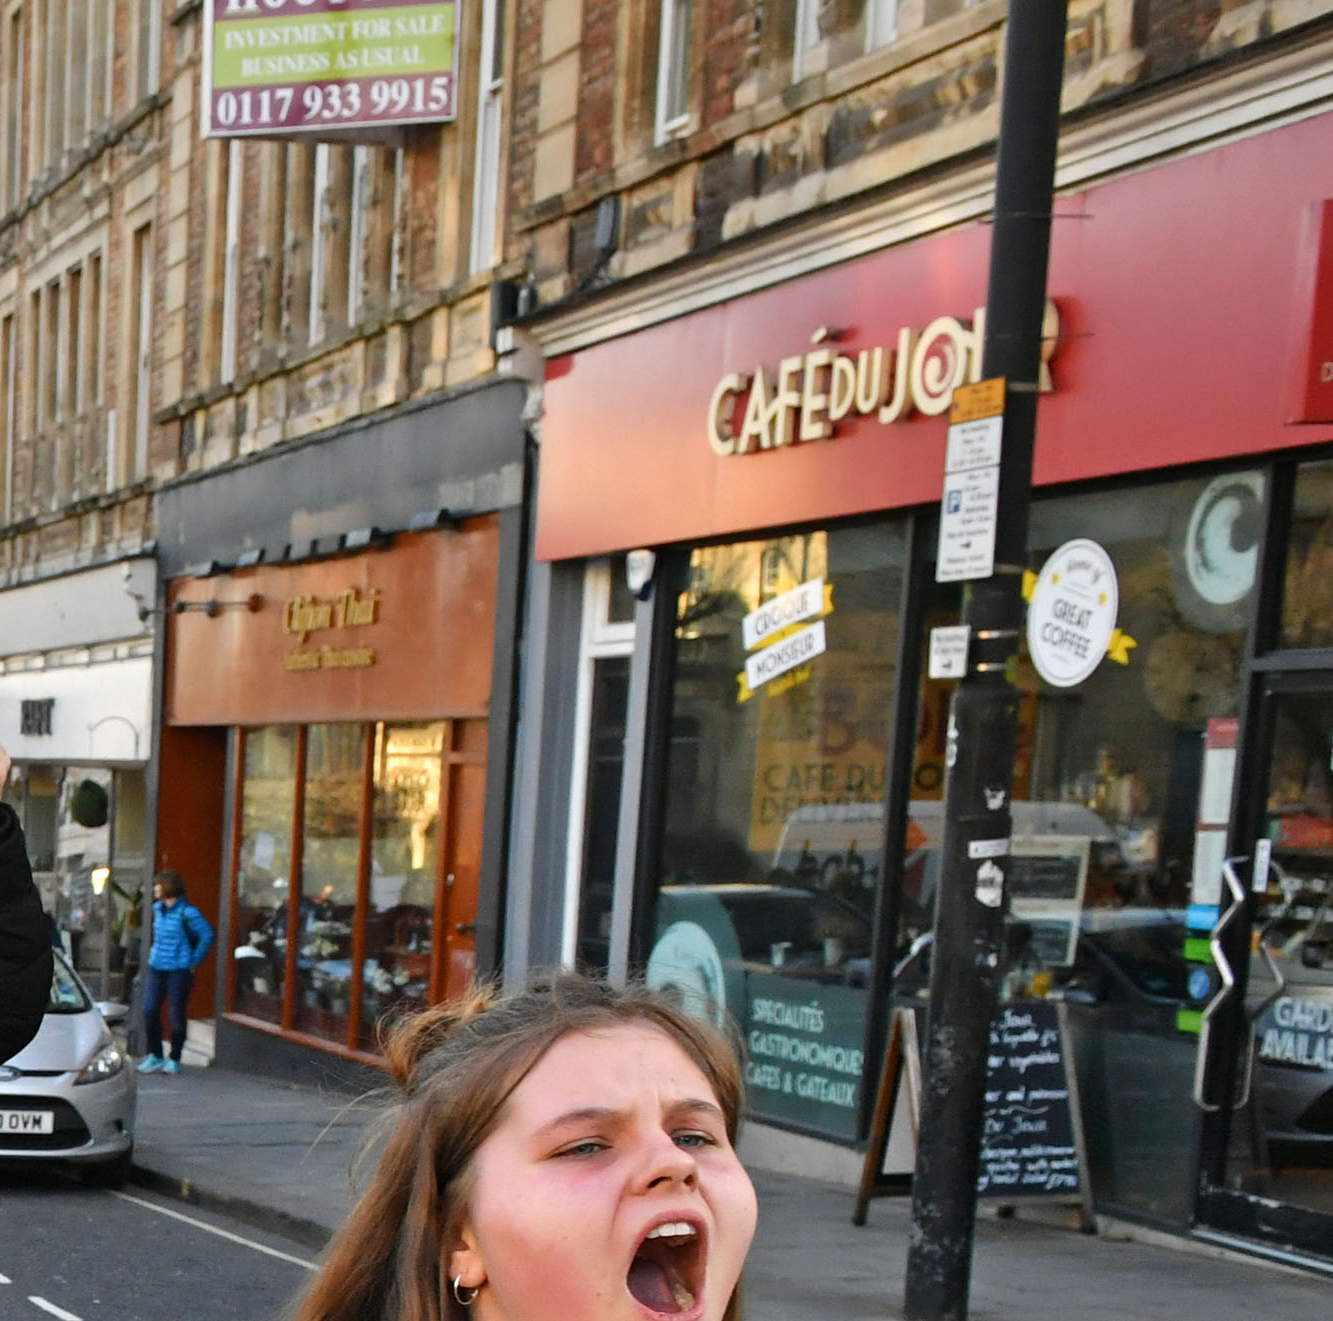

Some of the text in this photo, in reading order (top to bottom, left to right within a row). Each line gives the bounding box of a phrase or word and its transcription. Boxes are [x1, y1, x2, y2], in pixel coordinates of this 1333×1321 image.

[225, 14, 445, 50] INVESTMENT FOR SALE
[241, 45, 425, 77] BUSINESS AS USUAL
[216, 76, 450, 126] 0117 933 9915
[708, 325, 833, 456] CAFÉ
[1053, 599, 1093, 630] GREAT
[1040, 621, 1091, 660] COFFEE
[1274, 996, 1333, 1033] GARD
[783, 1071, 793, 1094] &
[8, 1113, 43, 1131] OVM
